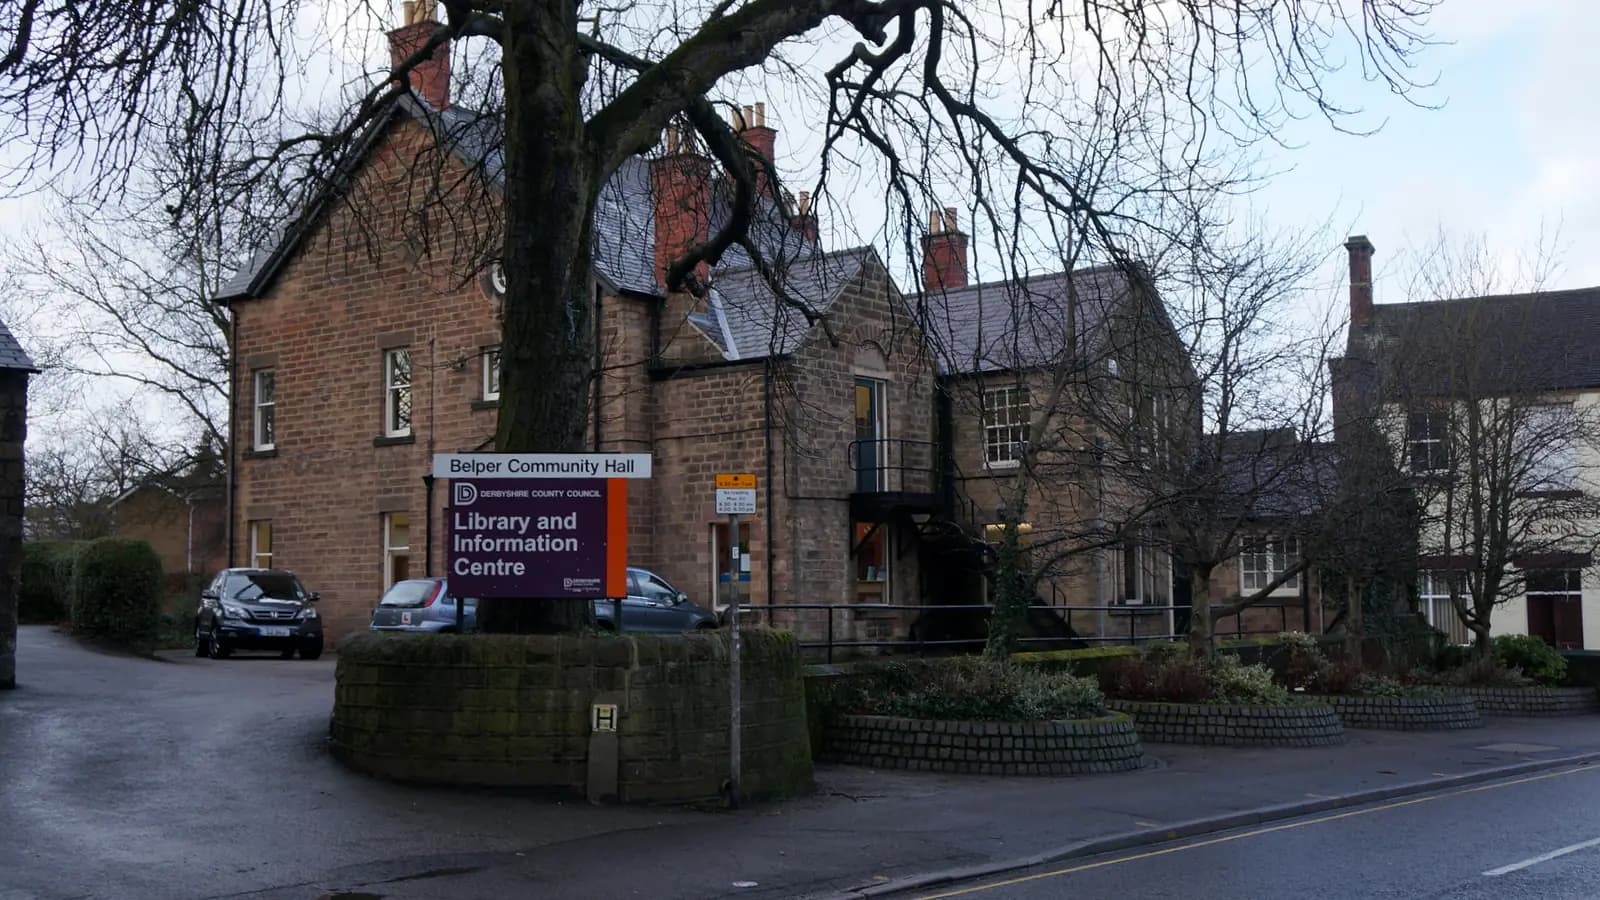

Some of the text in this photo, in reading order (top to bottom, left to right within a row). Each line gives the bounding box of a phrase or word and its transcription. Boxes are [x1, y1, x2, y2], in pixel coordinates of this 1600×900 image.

[450, 459, 635, 476] Belper Community Hall
[480, 490, 602, 498] DERBYSHIRE COUNTY COUNCIL
[454, 512, 577, 535] Library and
[454, 534, 578, 552] Information
[454, 557, 526, 576] Centre
[596, 707, 614, 729] H
